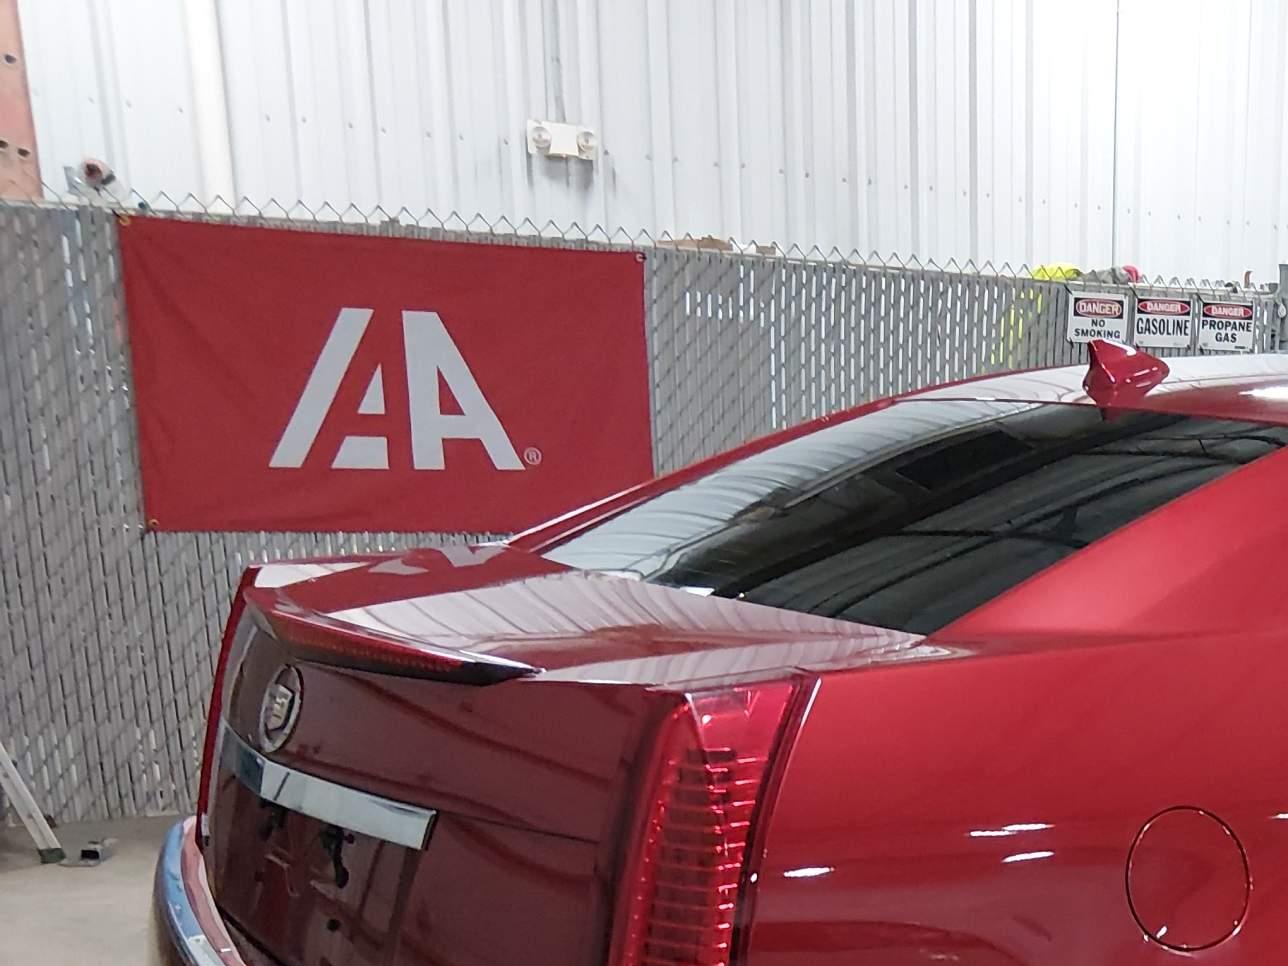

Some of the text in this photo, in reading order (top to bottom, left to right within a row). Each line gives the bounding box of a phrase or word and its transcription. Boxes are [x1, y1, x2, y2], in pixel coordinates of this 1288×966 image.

[1079, 302, 1119, 315] DANGER
[1146, 301, 1182, 313] DANGER
[1211, 305, 1244, 318] DANGER
[1091, 319, 1106, 328] NO
[1136, 317, 1190, 337] GASOLINE
[1201, 320, 1253, 332] PROPANE
[1074, 328, 1121, 339] SMOKING
[1215, 332, 1238, 344] GAS
